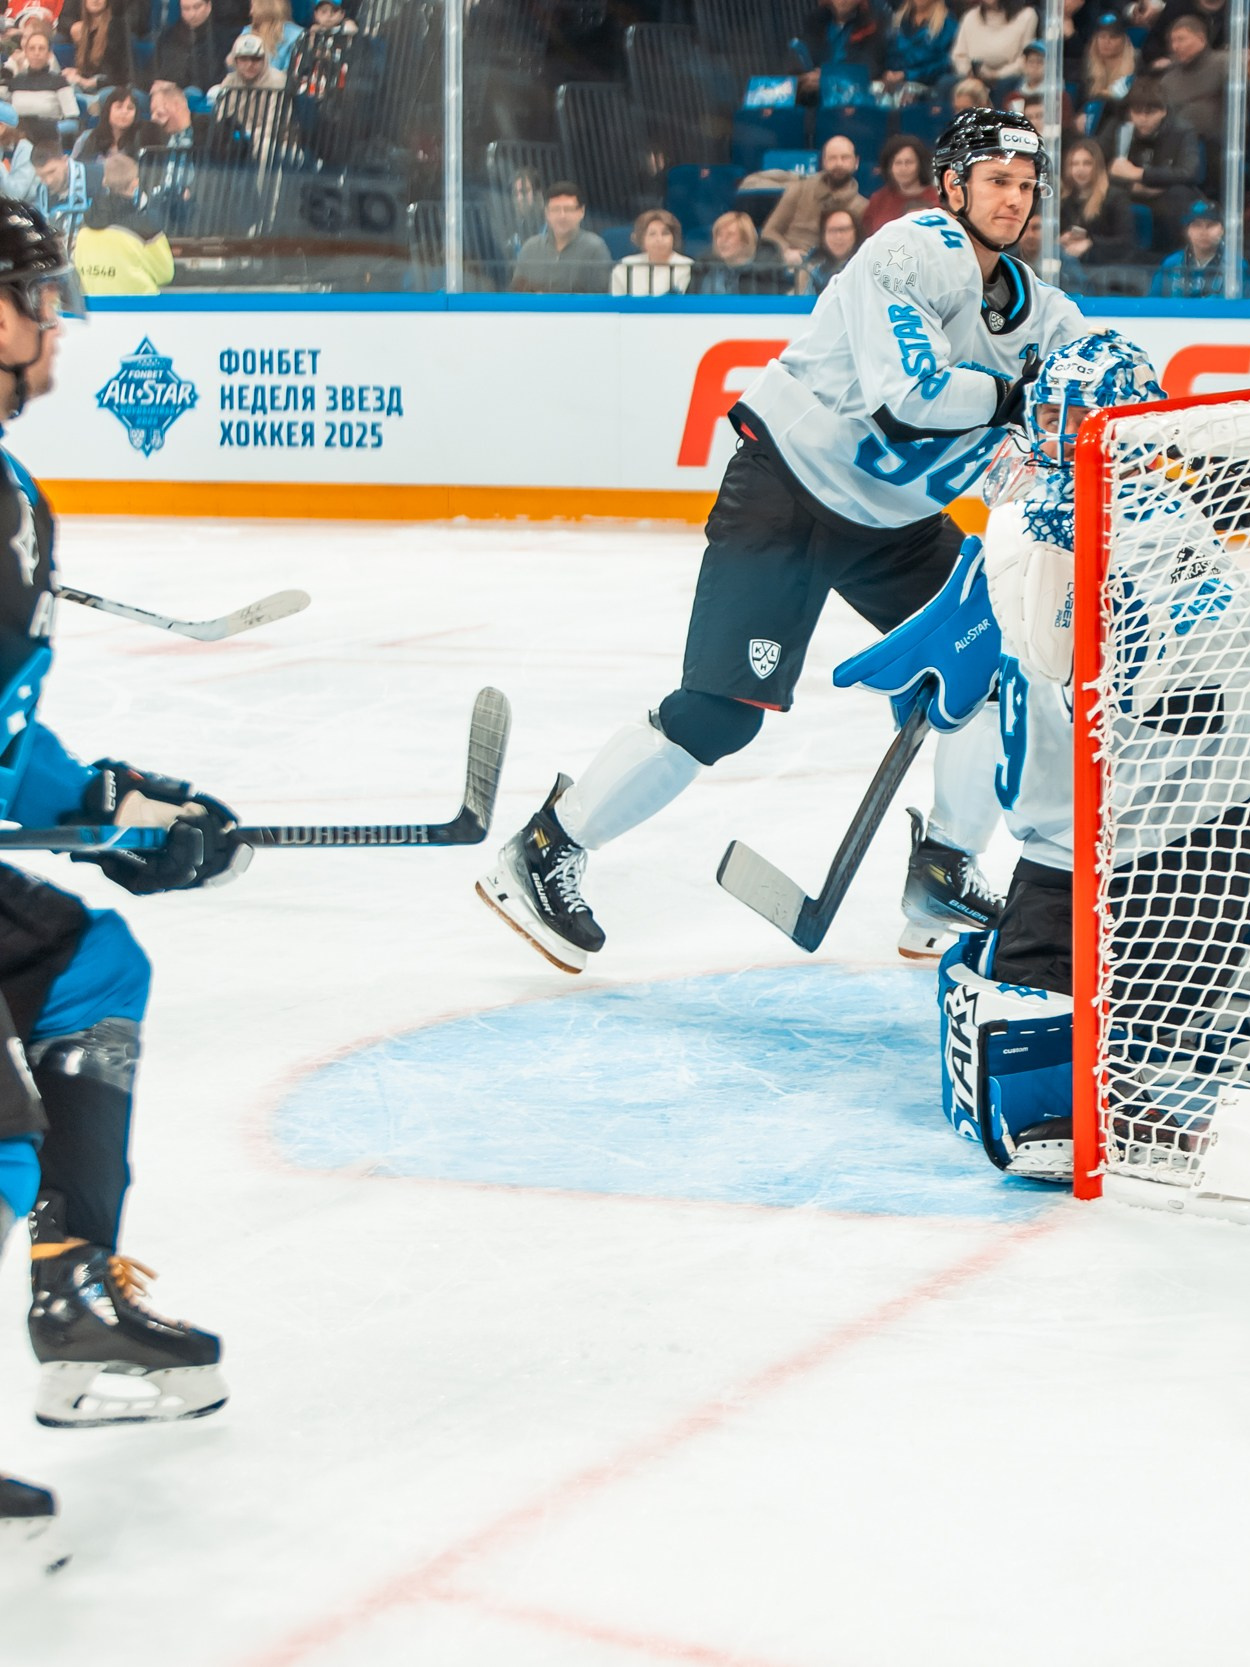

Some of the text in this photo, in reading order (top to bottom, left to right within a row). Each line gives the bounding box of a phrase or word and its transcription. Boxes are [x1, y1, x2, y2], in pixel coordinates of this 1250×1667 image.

[219, 347, 321, 376] ФОНБЕТ
[220, 384, 404, 417] НЕДЕЛЯ ЗВЕЗД
[219, 420, 383, 448] ХОККЕЯ 2025
[1054, 609, 1064, 629] PRO
[103, 769, 116, 811] CCM
[279, 825, 430, 844] WARRIOR
